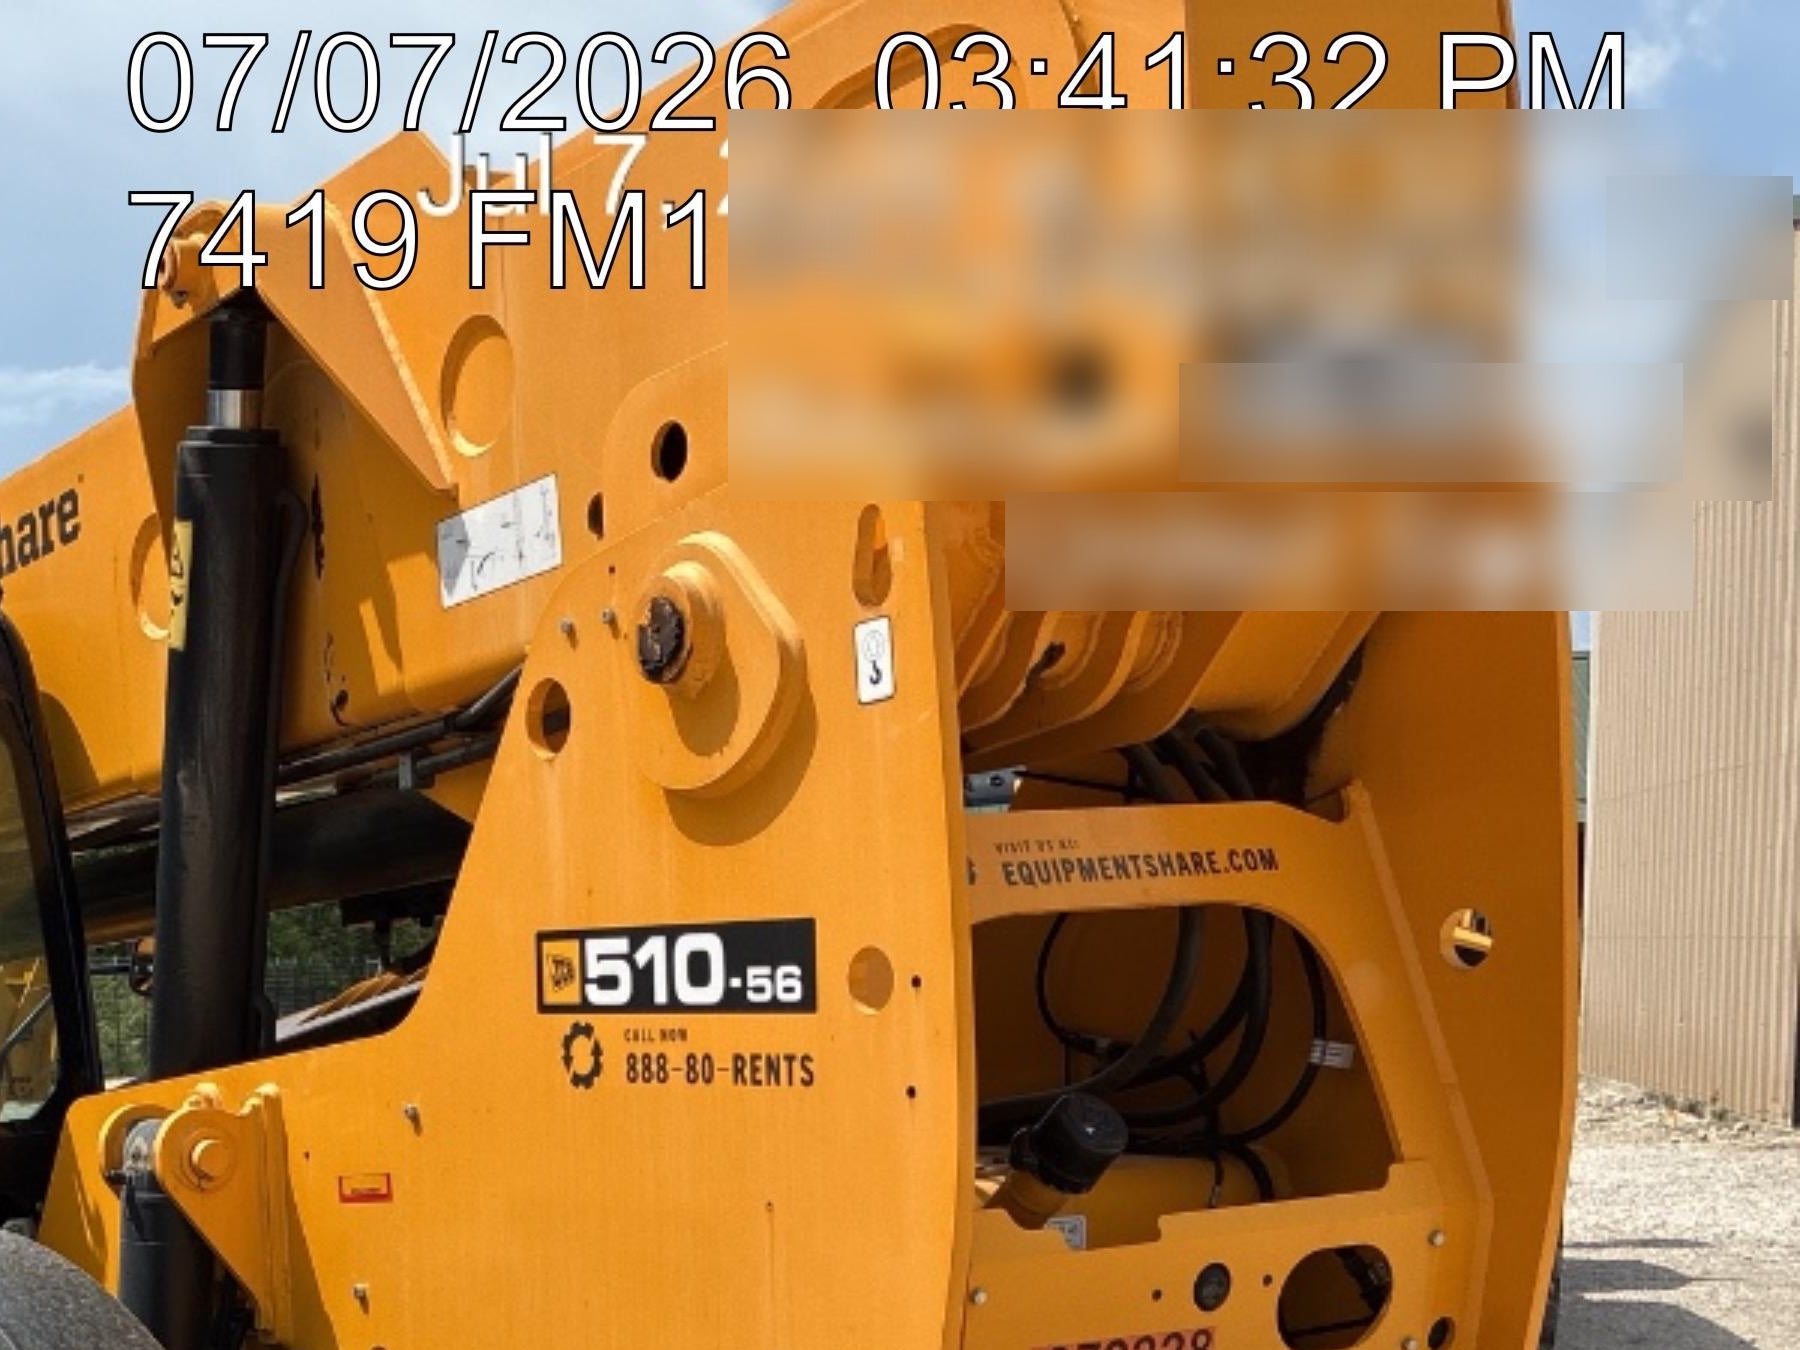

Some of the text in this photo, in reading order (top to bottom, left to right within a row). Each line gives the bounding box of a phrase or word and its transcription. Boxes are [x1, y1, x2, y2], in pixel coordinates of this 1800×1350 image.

[1001, 848, 1279, 887] EQUIPMENTSHARE.COM
[584, 932, 803, 1006] 510-56
[624, 1027, 688, 1043] CALL NOW
[626, 1052, 815, 1087] 888-80-RENTS
